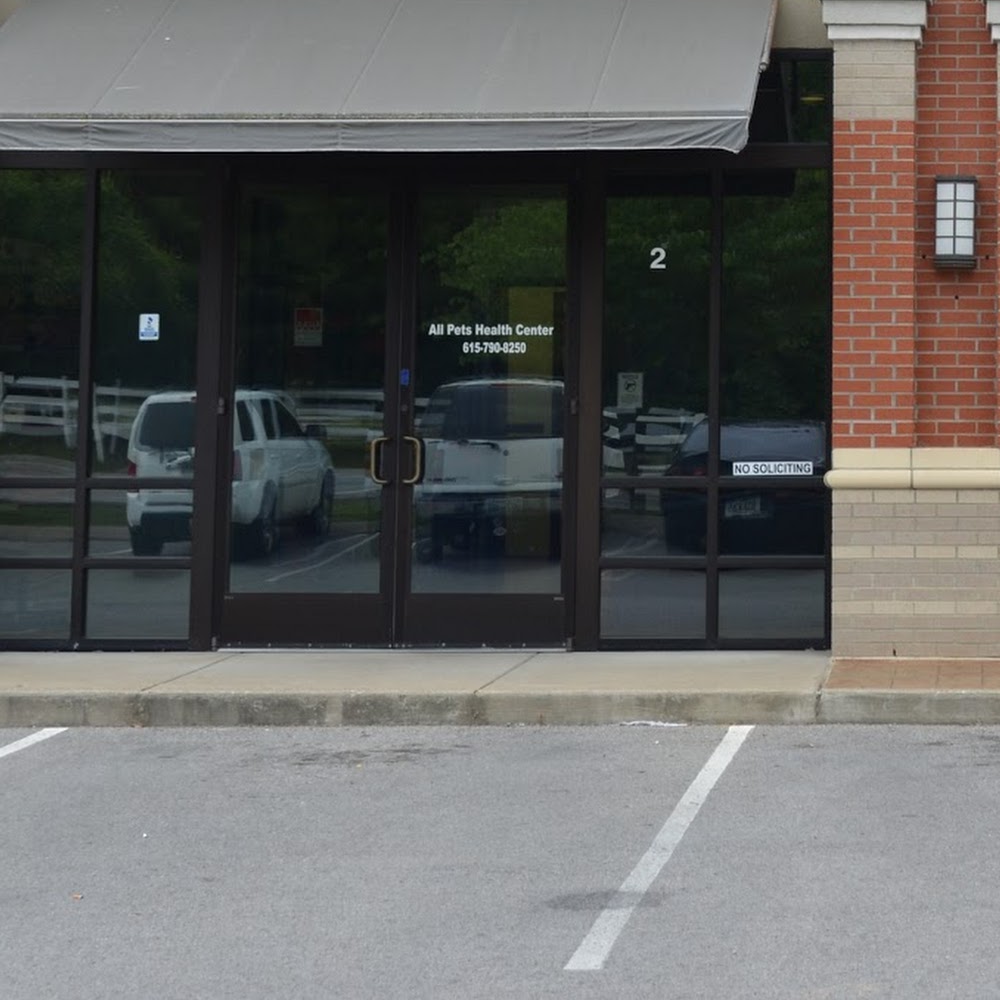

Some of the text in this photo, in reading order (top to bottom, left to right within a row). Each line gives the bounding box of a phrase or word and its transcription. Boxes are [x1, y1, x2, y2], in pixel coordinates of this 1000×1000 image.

[650, 247, 667, 269] 2
[428, 323, 554, 336] All Pets Health Center
[462, 342, 527, 354] 615-790-8250
[735, 463, 811, 474] NO SOLICITING
